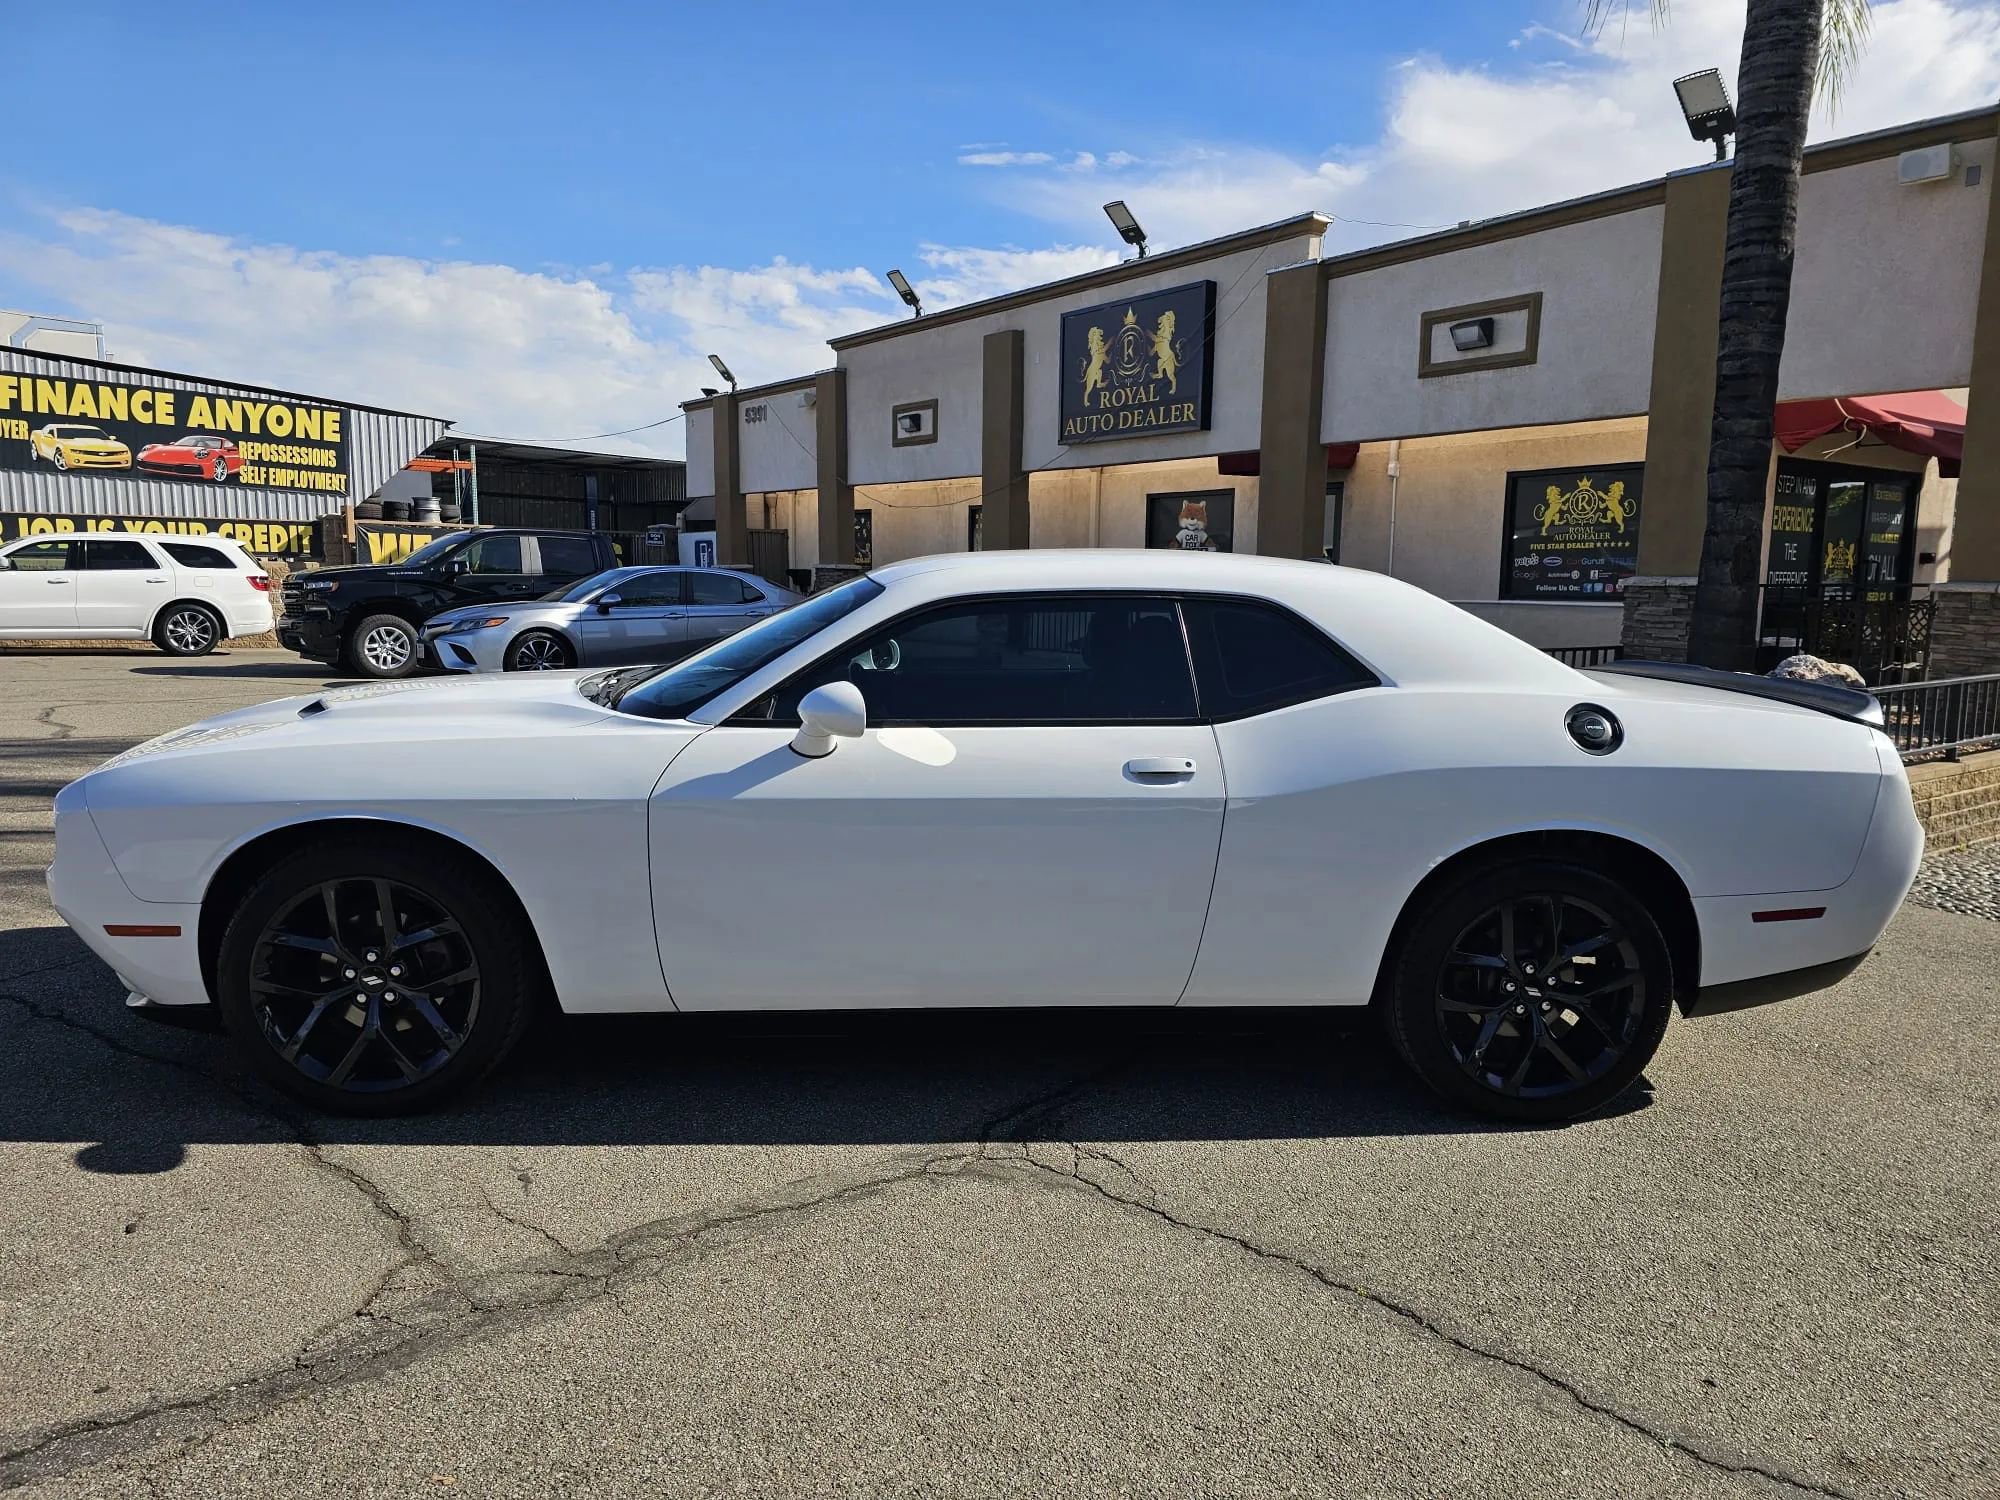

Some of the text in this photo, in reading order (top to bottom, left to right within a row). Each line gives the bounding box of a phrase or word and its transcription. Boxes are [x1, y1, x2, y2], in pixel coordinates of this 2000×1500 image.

[1100, 384, 1160, 409] ROYAL
[0, 375, 341, 442] FINANCE ANYONE
[745, 405, 767, 424] 5391
[1064, 403, 1197, 435] AUTO DEALER
[239, 440, 337, 468] REPOSSESSIONS
[240, 465, 347, 492] SELF EMPLOYMENT
[1777, 474, 1795, 493] STEP
[1772, 505, 1815, 532] EXPERIENCE
[1185, 534, 1199, 542] CAR
[1569, 526, 1596, 534] ROYAL
[1577, 532, 1611, 540] DEALER
[1547, 542, 1564, 550] STAR
[1784, 543, 1798, 560] THE
[1880, 555, 1896, 580] ALL
[1768, 571, 1808, 588] DIFFERENCE
